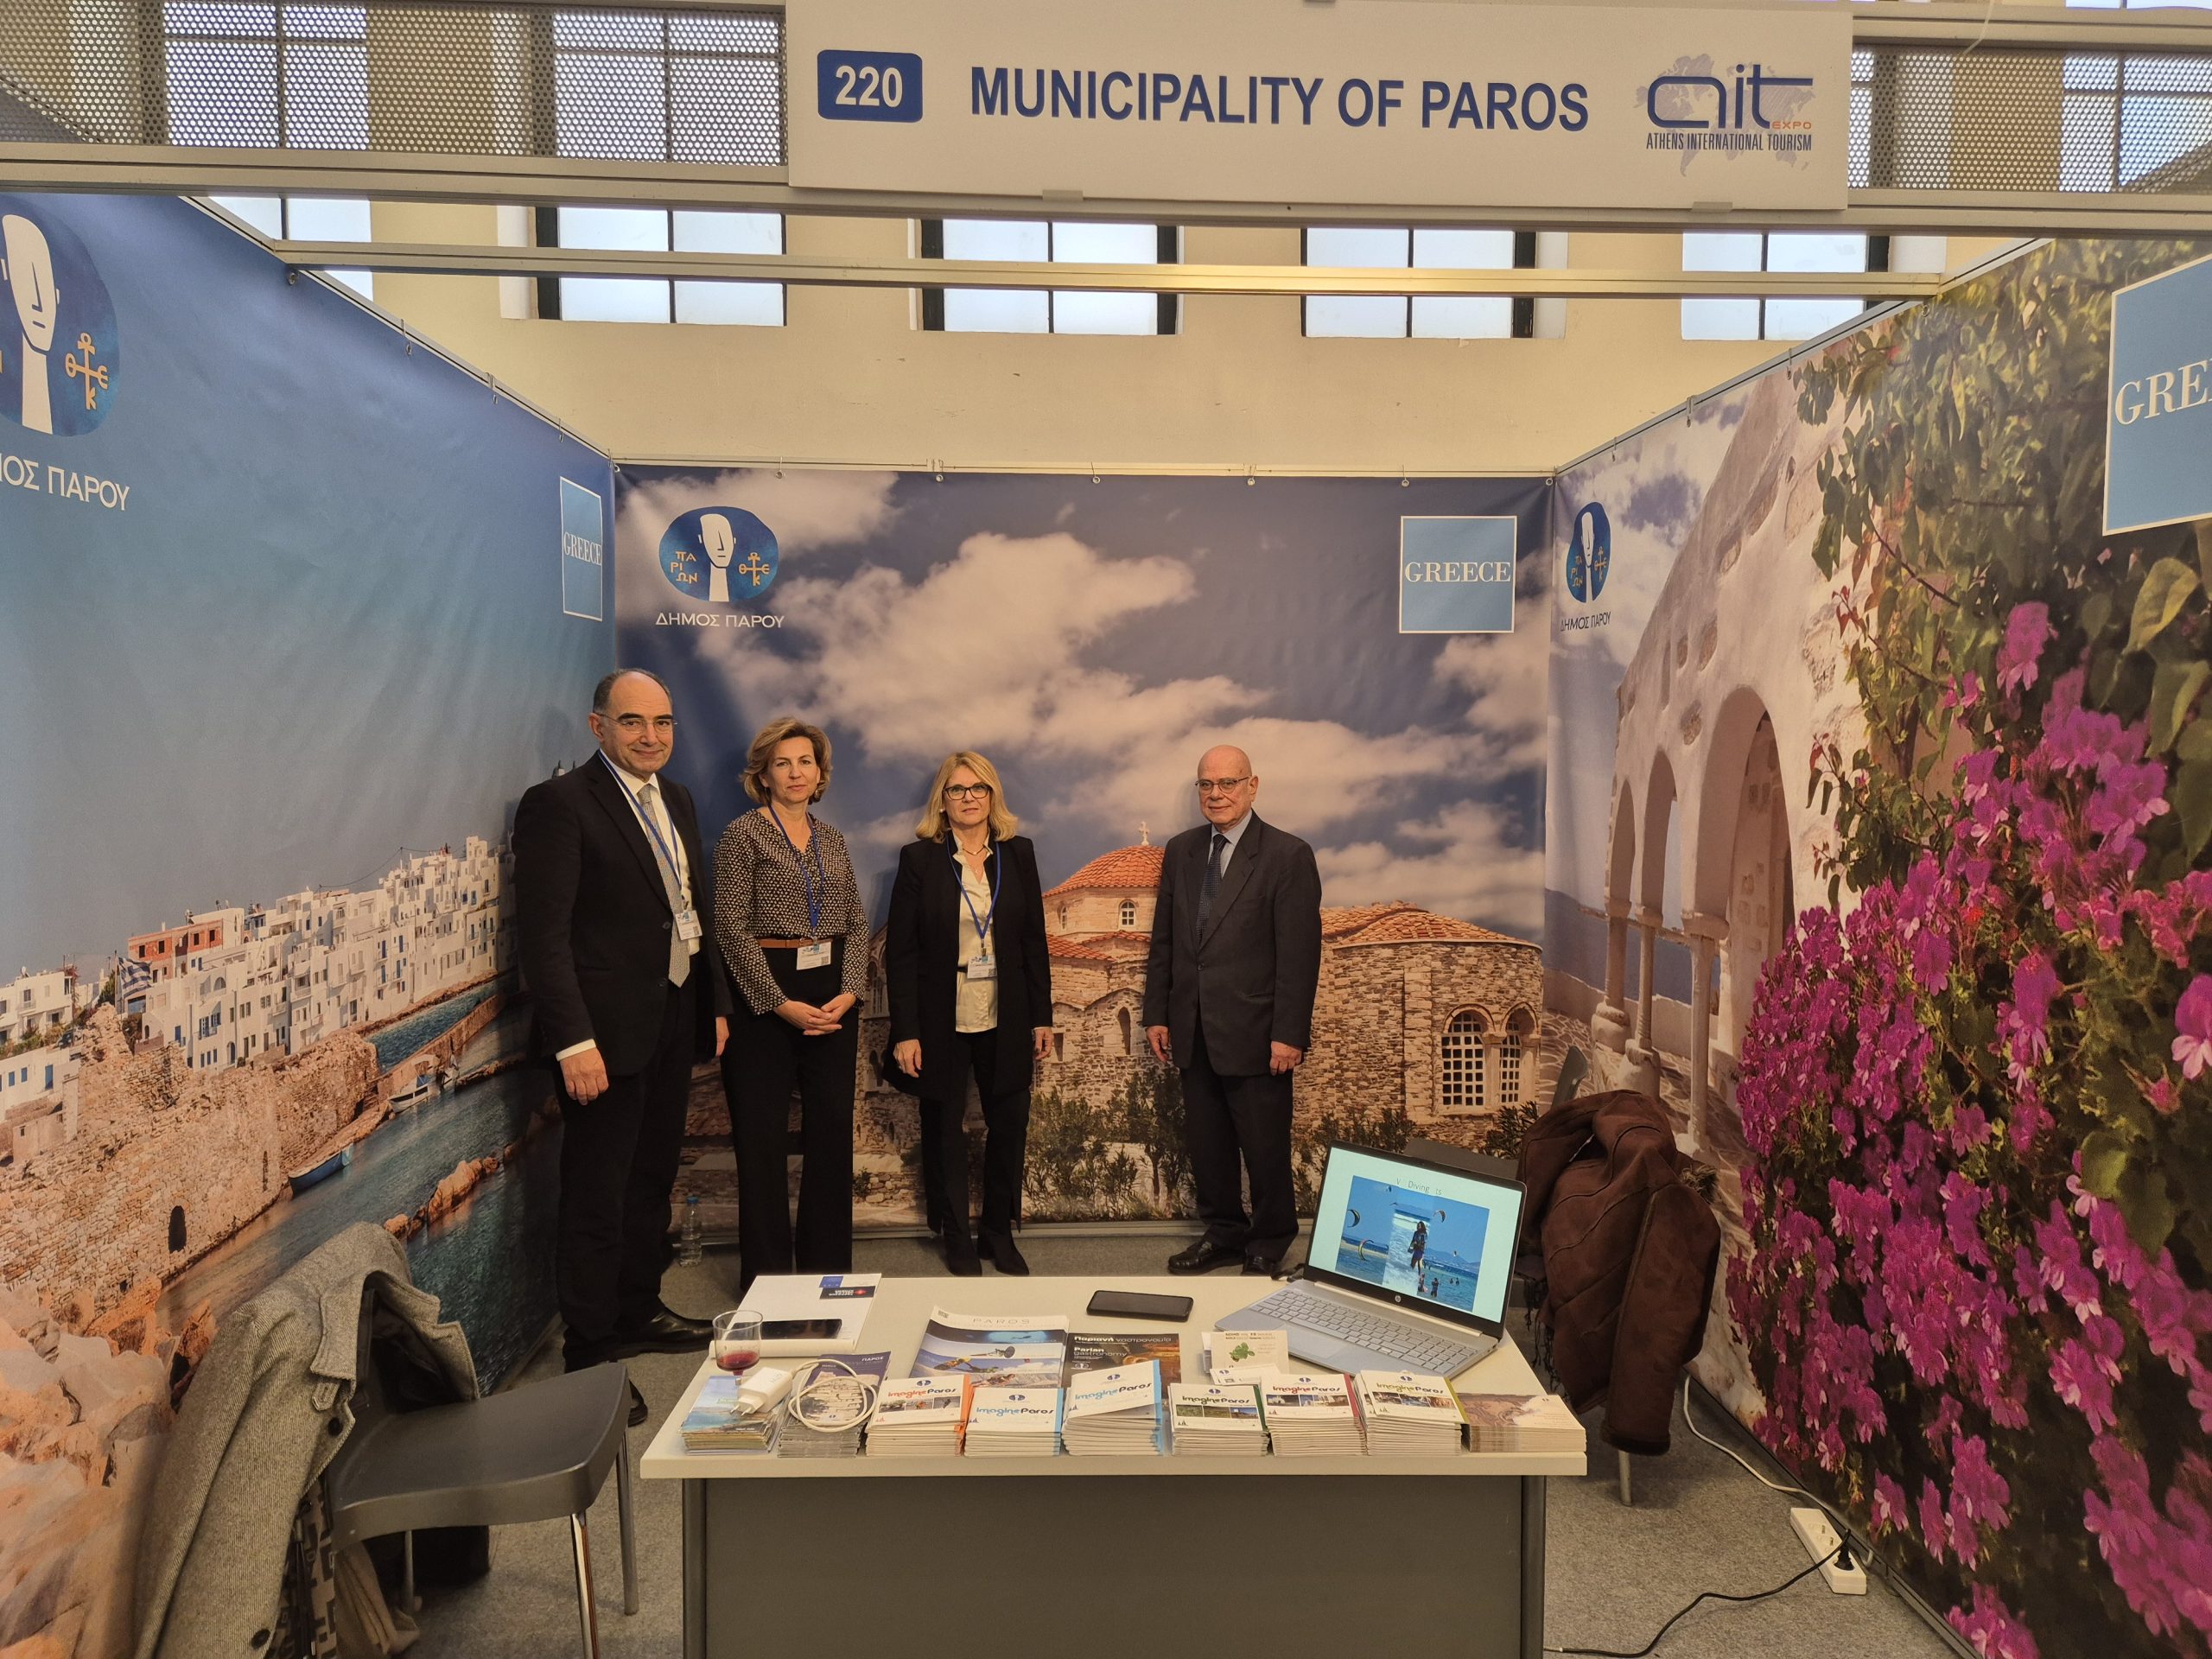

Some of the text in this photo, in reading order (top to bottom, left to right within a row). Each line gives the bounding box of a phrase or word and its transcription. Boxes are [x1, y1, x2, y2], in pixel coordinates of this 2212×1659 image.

[835, 65, 904, 108] 220
[971, 67, 1589, 131] MUNICIPALITY OF PAROS
[1647, 64, 1813, 129] ait
[1772, 121, 1812, 130] EXPO
[1646, 133, 1812, 151] ATHENS INTERNATIONAL TOURISM
[2114, 358, 2212, 425] GRE
[0, 453, 130, 511] ΟΣ ΠΑΡΟΥ
[563, 531, 602, 566] GREECE
[1405, 562, 1511, 582] GREECE
[656, 613, 785, 628] ΔΗΜΟΣ ΠΑΡΟΥ
[1560, 611, 1611, 632] ΔΗΜΟΣ ΠΑΡΟΥ
[1408, 1180, 1430, 1193] Diving
